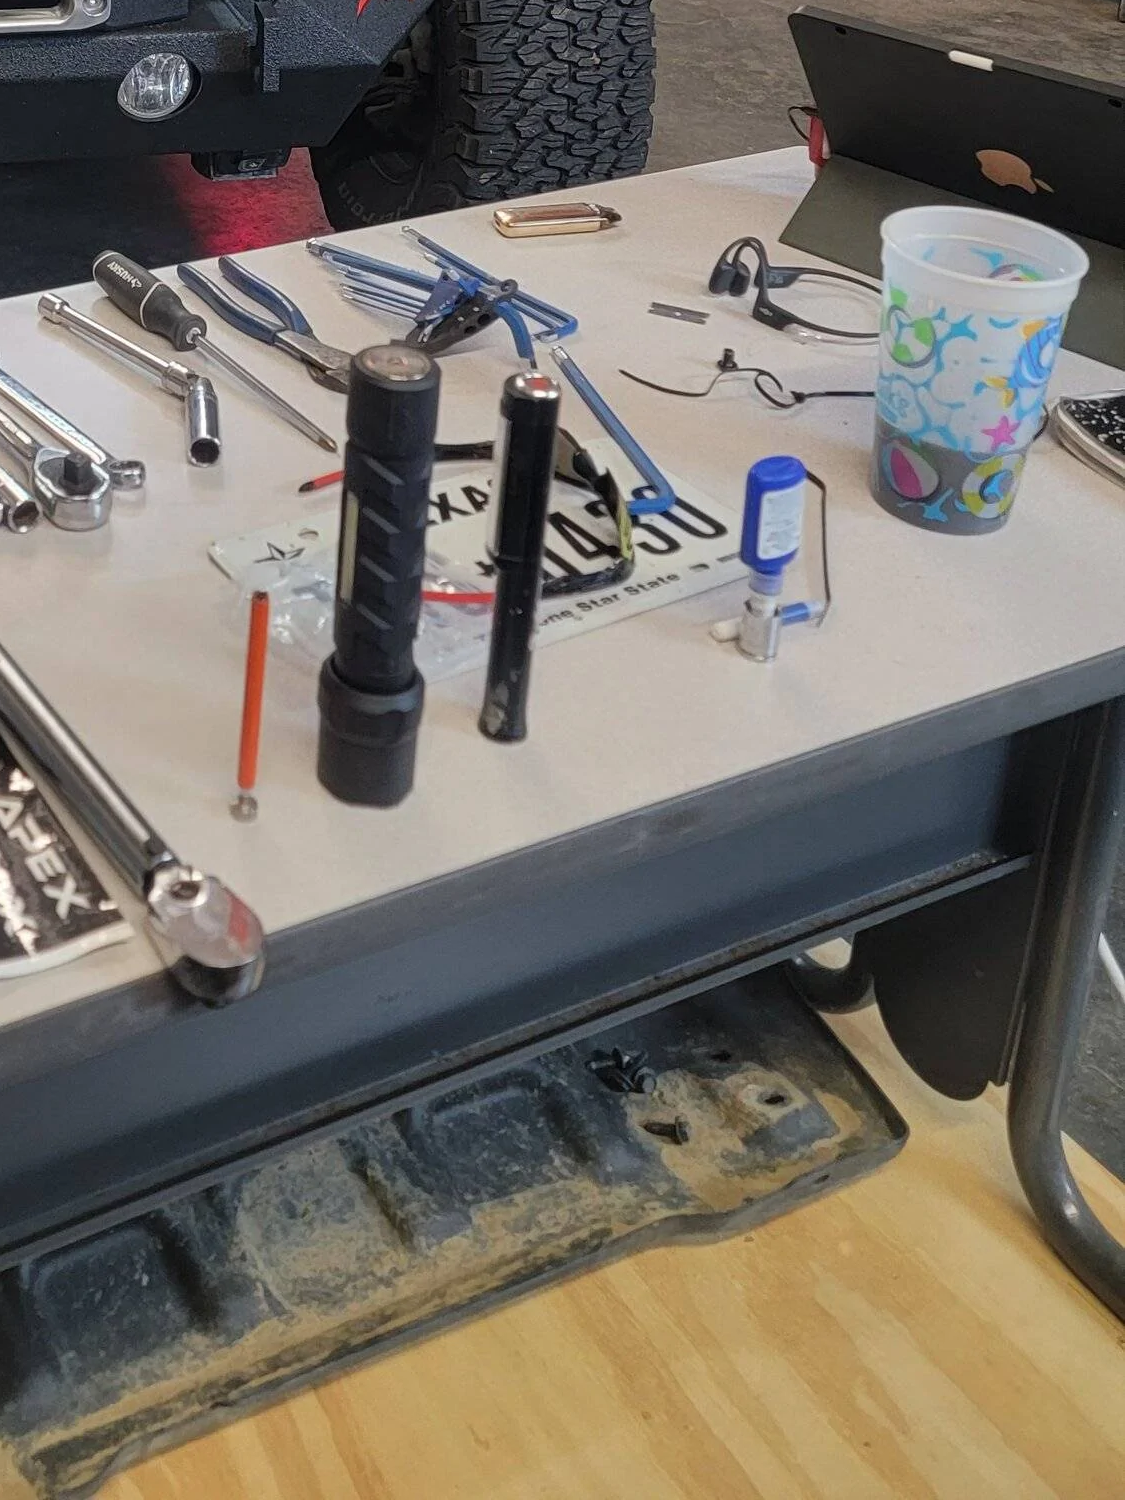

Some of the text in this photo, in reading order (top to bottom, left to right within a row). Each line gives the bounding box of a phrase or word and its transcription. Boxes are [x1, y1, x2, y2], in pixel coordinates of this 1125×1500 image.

[106, 261, 135, 283] HUSKY
[576, 593, 621, 613] Star
[623, 572, 681, 596] State
